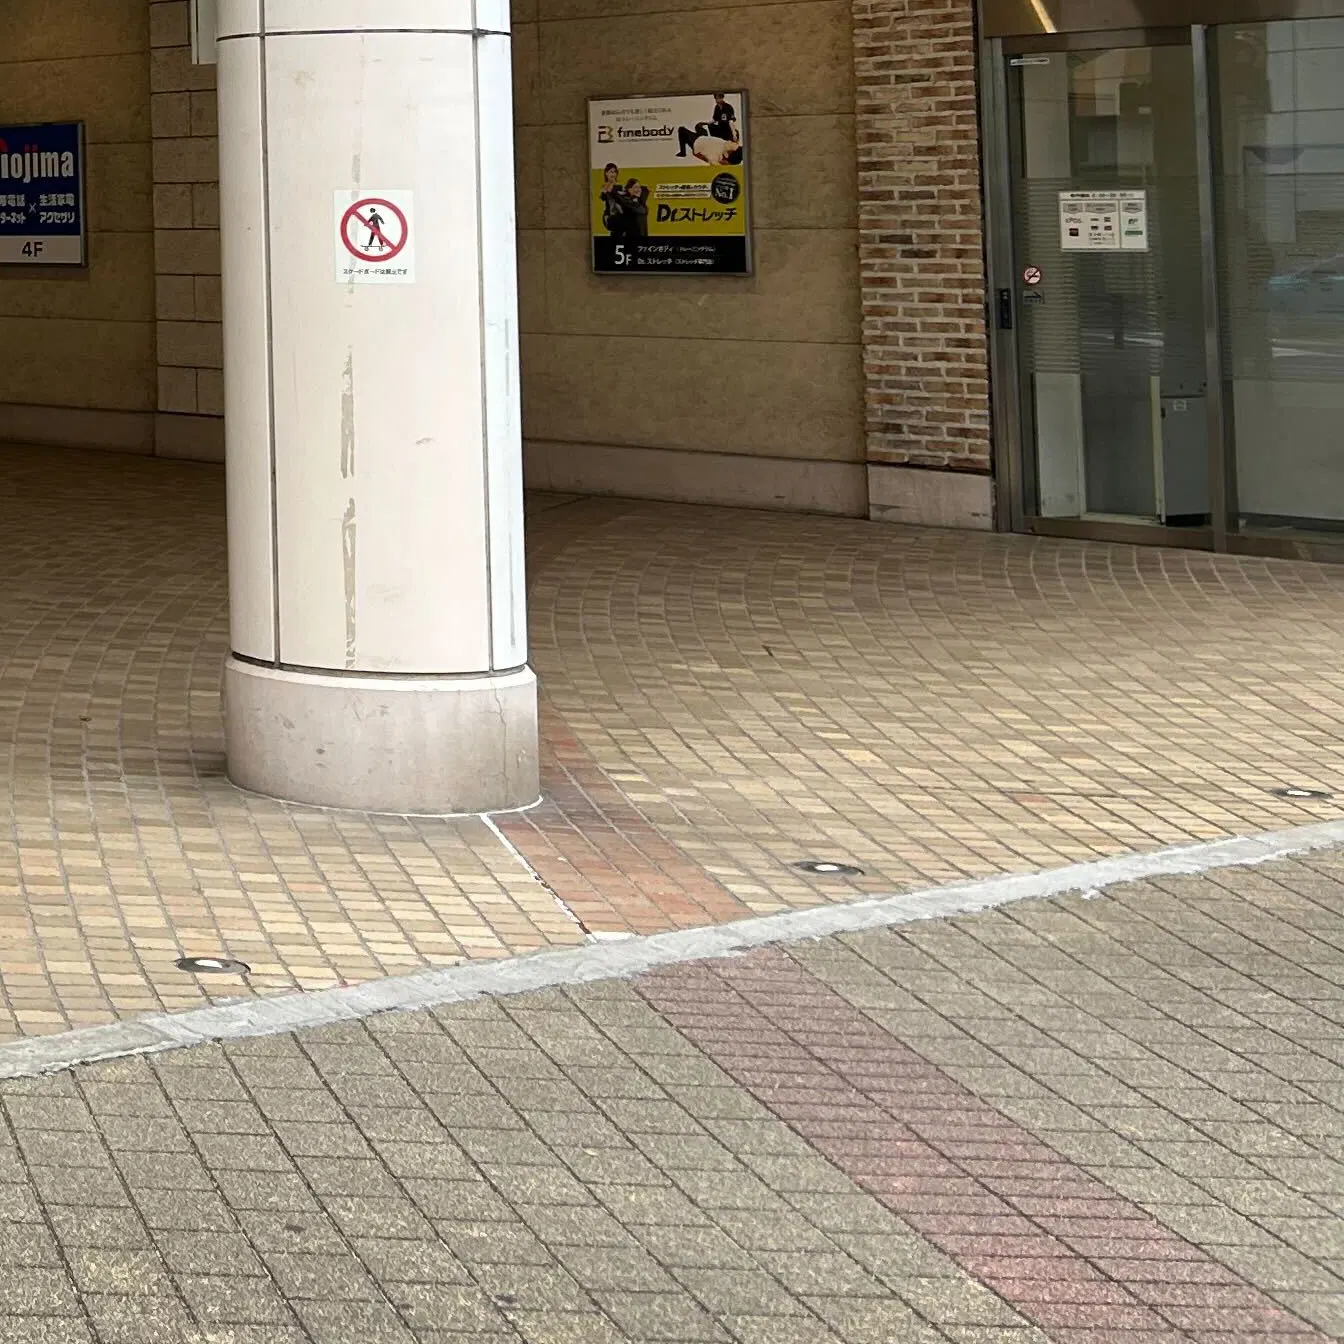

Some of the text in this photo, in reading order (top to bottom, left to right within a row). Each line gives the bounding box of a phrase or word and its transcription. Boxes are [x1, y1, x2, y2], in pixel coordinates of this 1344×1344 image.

[617, 125, 674, 138] finebody
[21, 240, 43, 257] 4F
[614, 244, 633, 267] 5F
